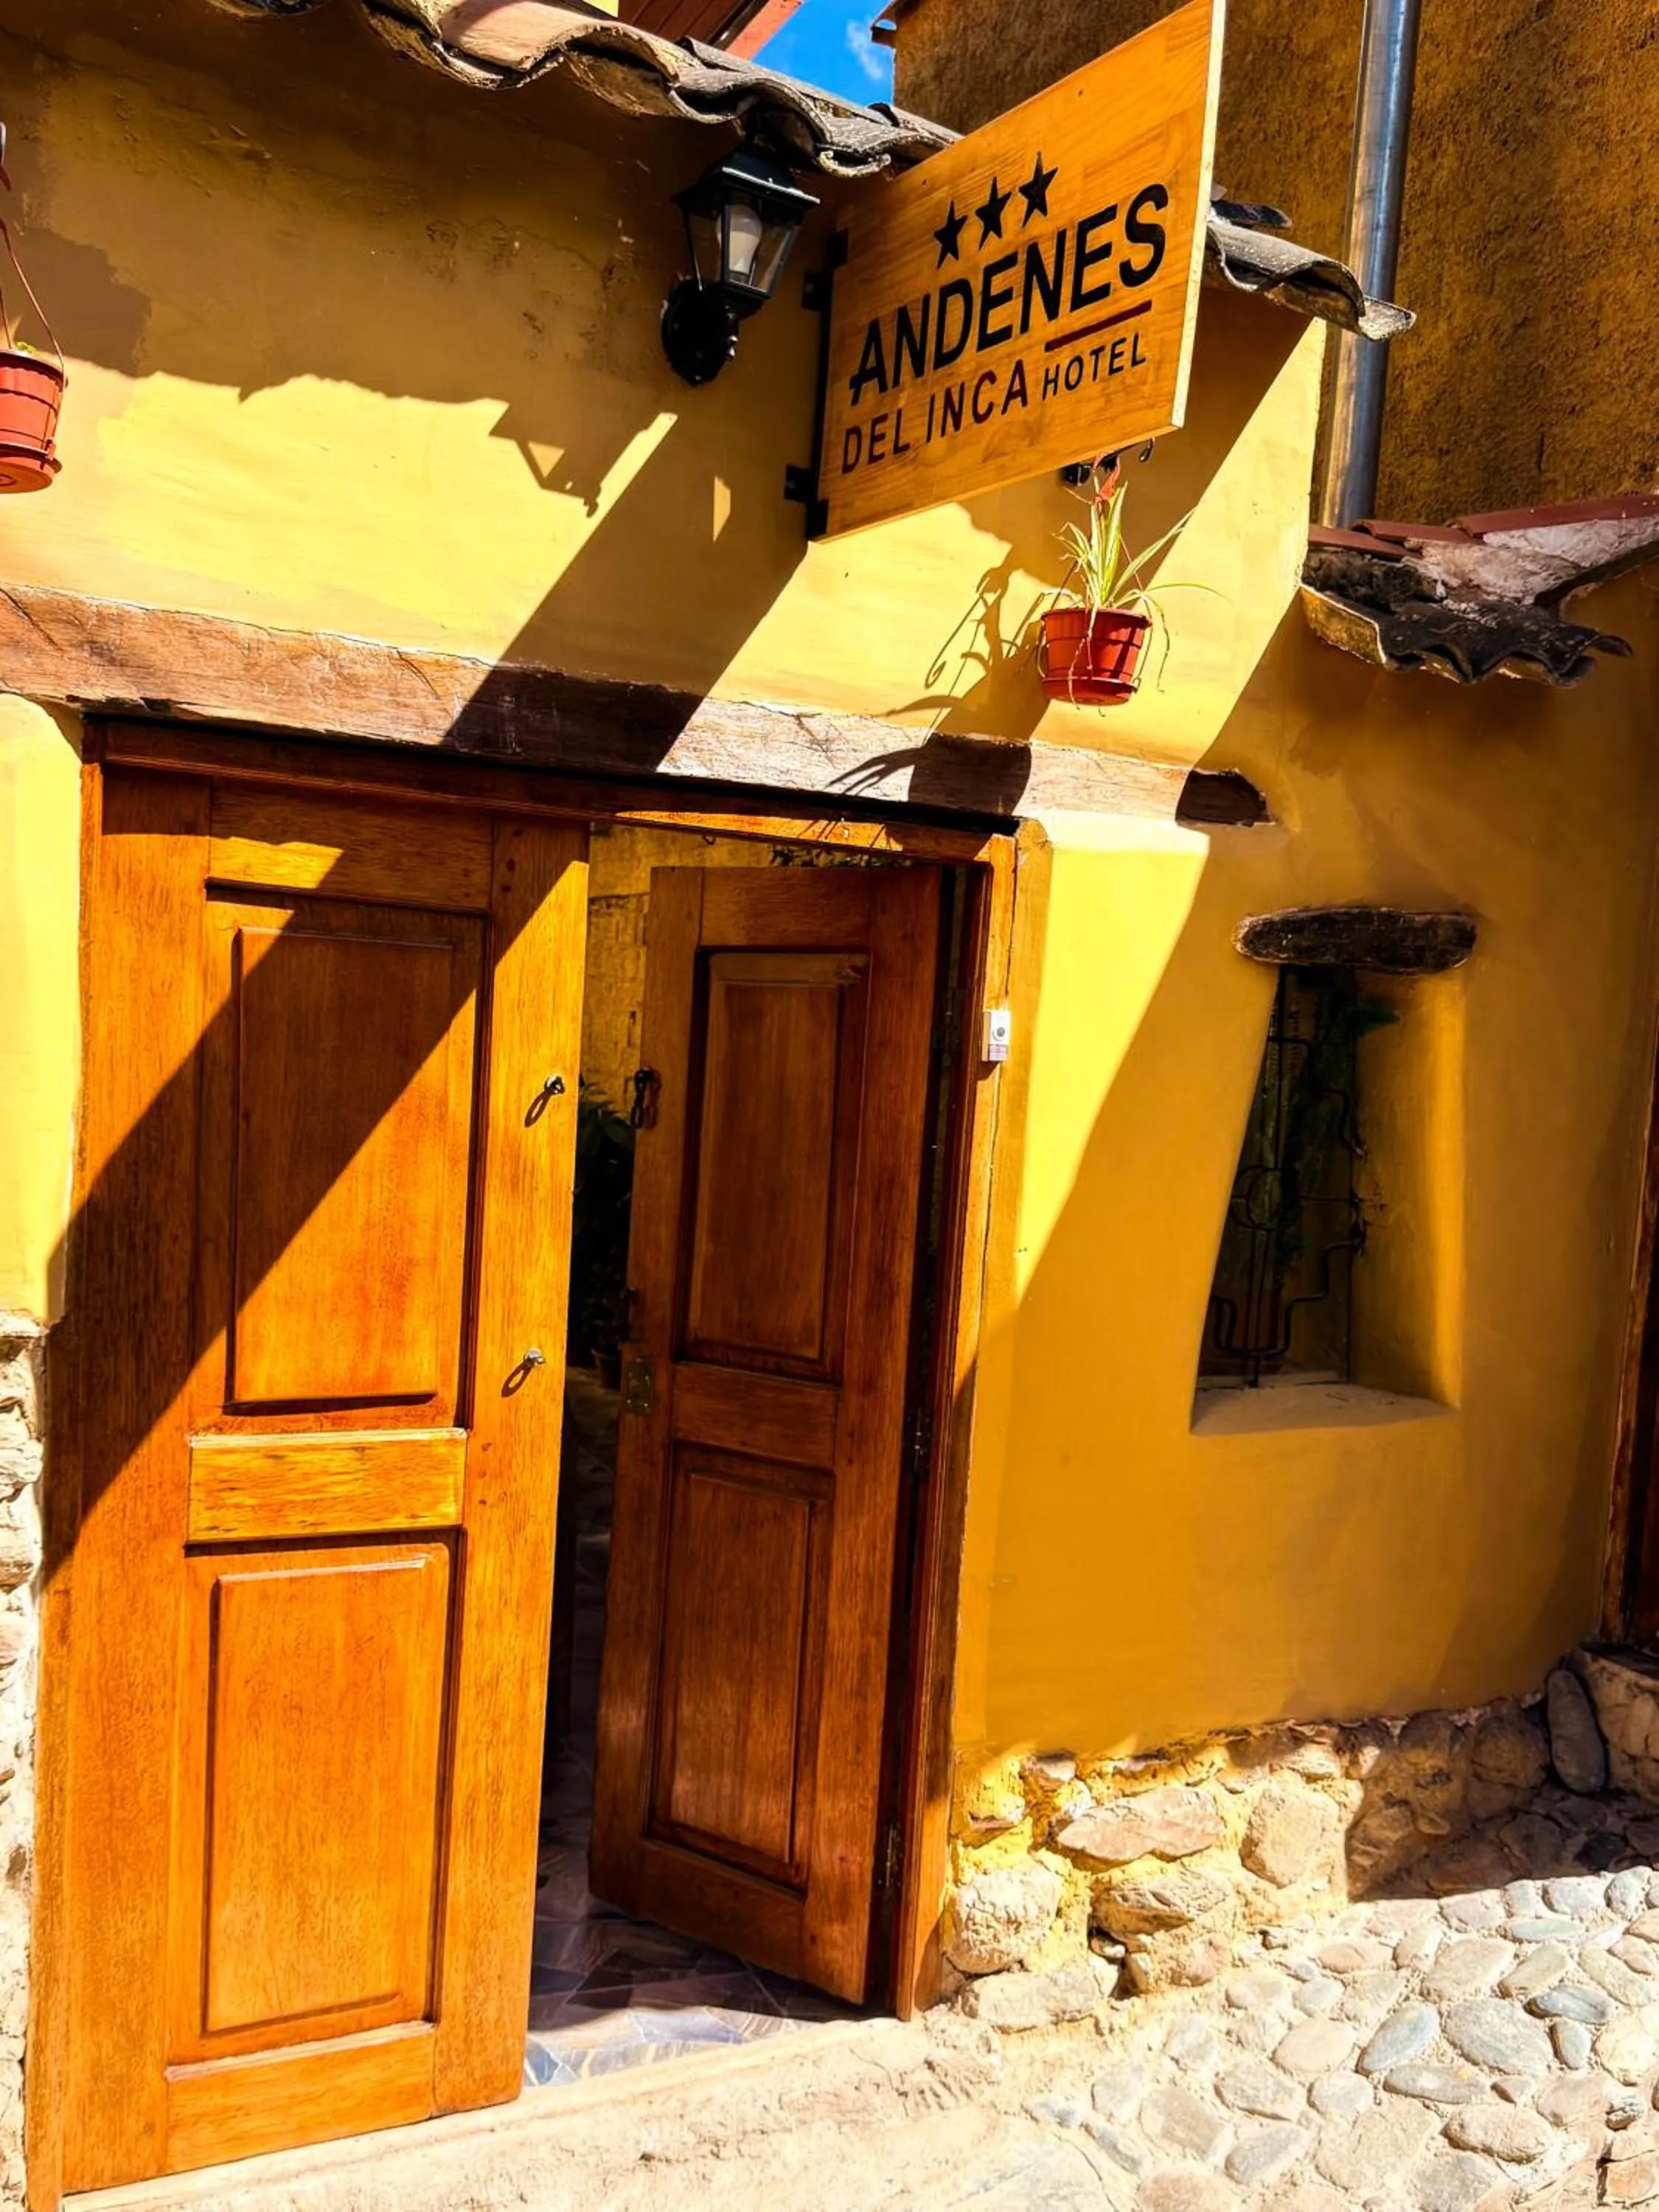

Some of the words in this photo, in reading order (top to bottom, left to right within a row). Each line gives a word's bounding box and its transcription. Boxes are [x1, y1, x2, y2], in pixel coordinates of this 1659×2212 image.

[849, 183, 1169, 406] ANDENES
[841, 408, 911, 475] DEL
[925, 358, 1029, 443] INCA
[1041, 332, 1147, 402] HOTEL
